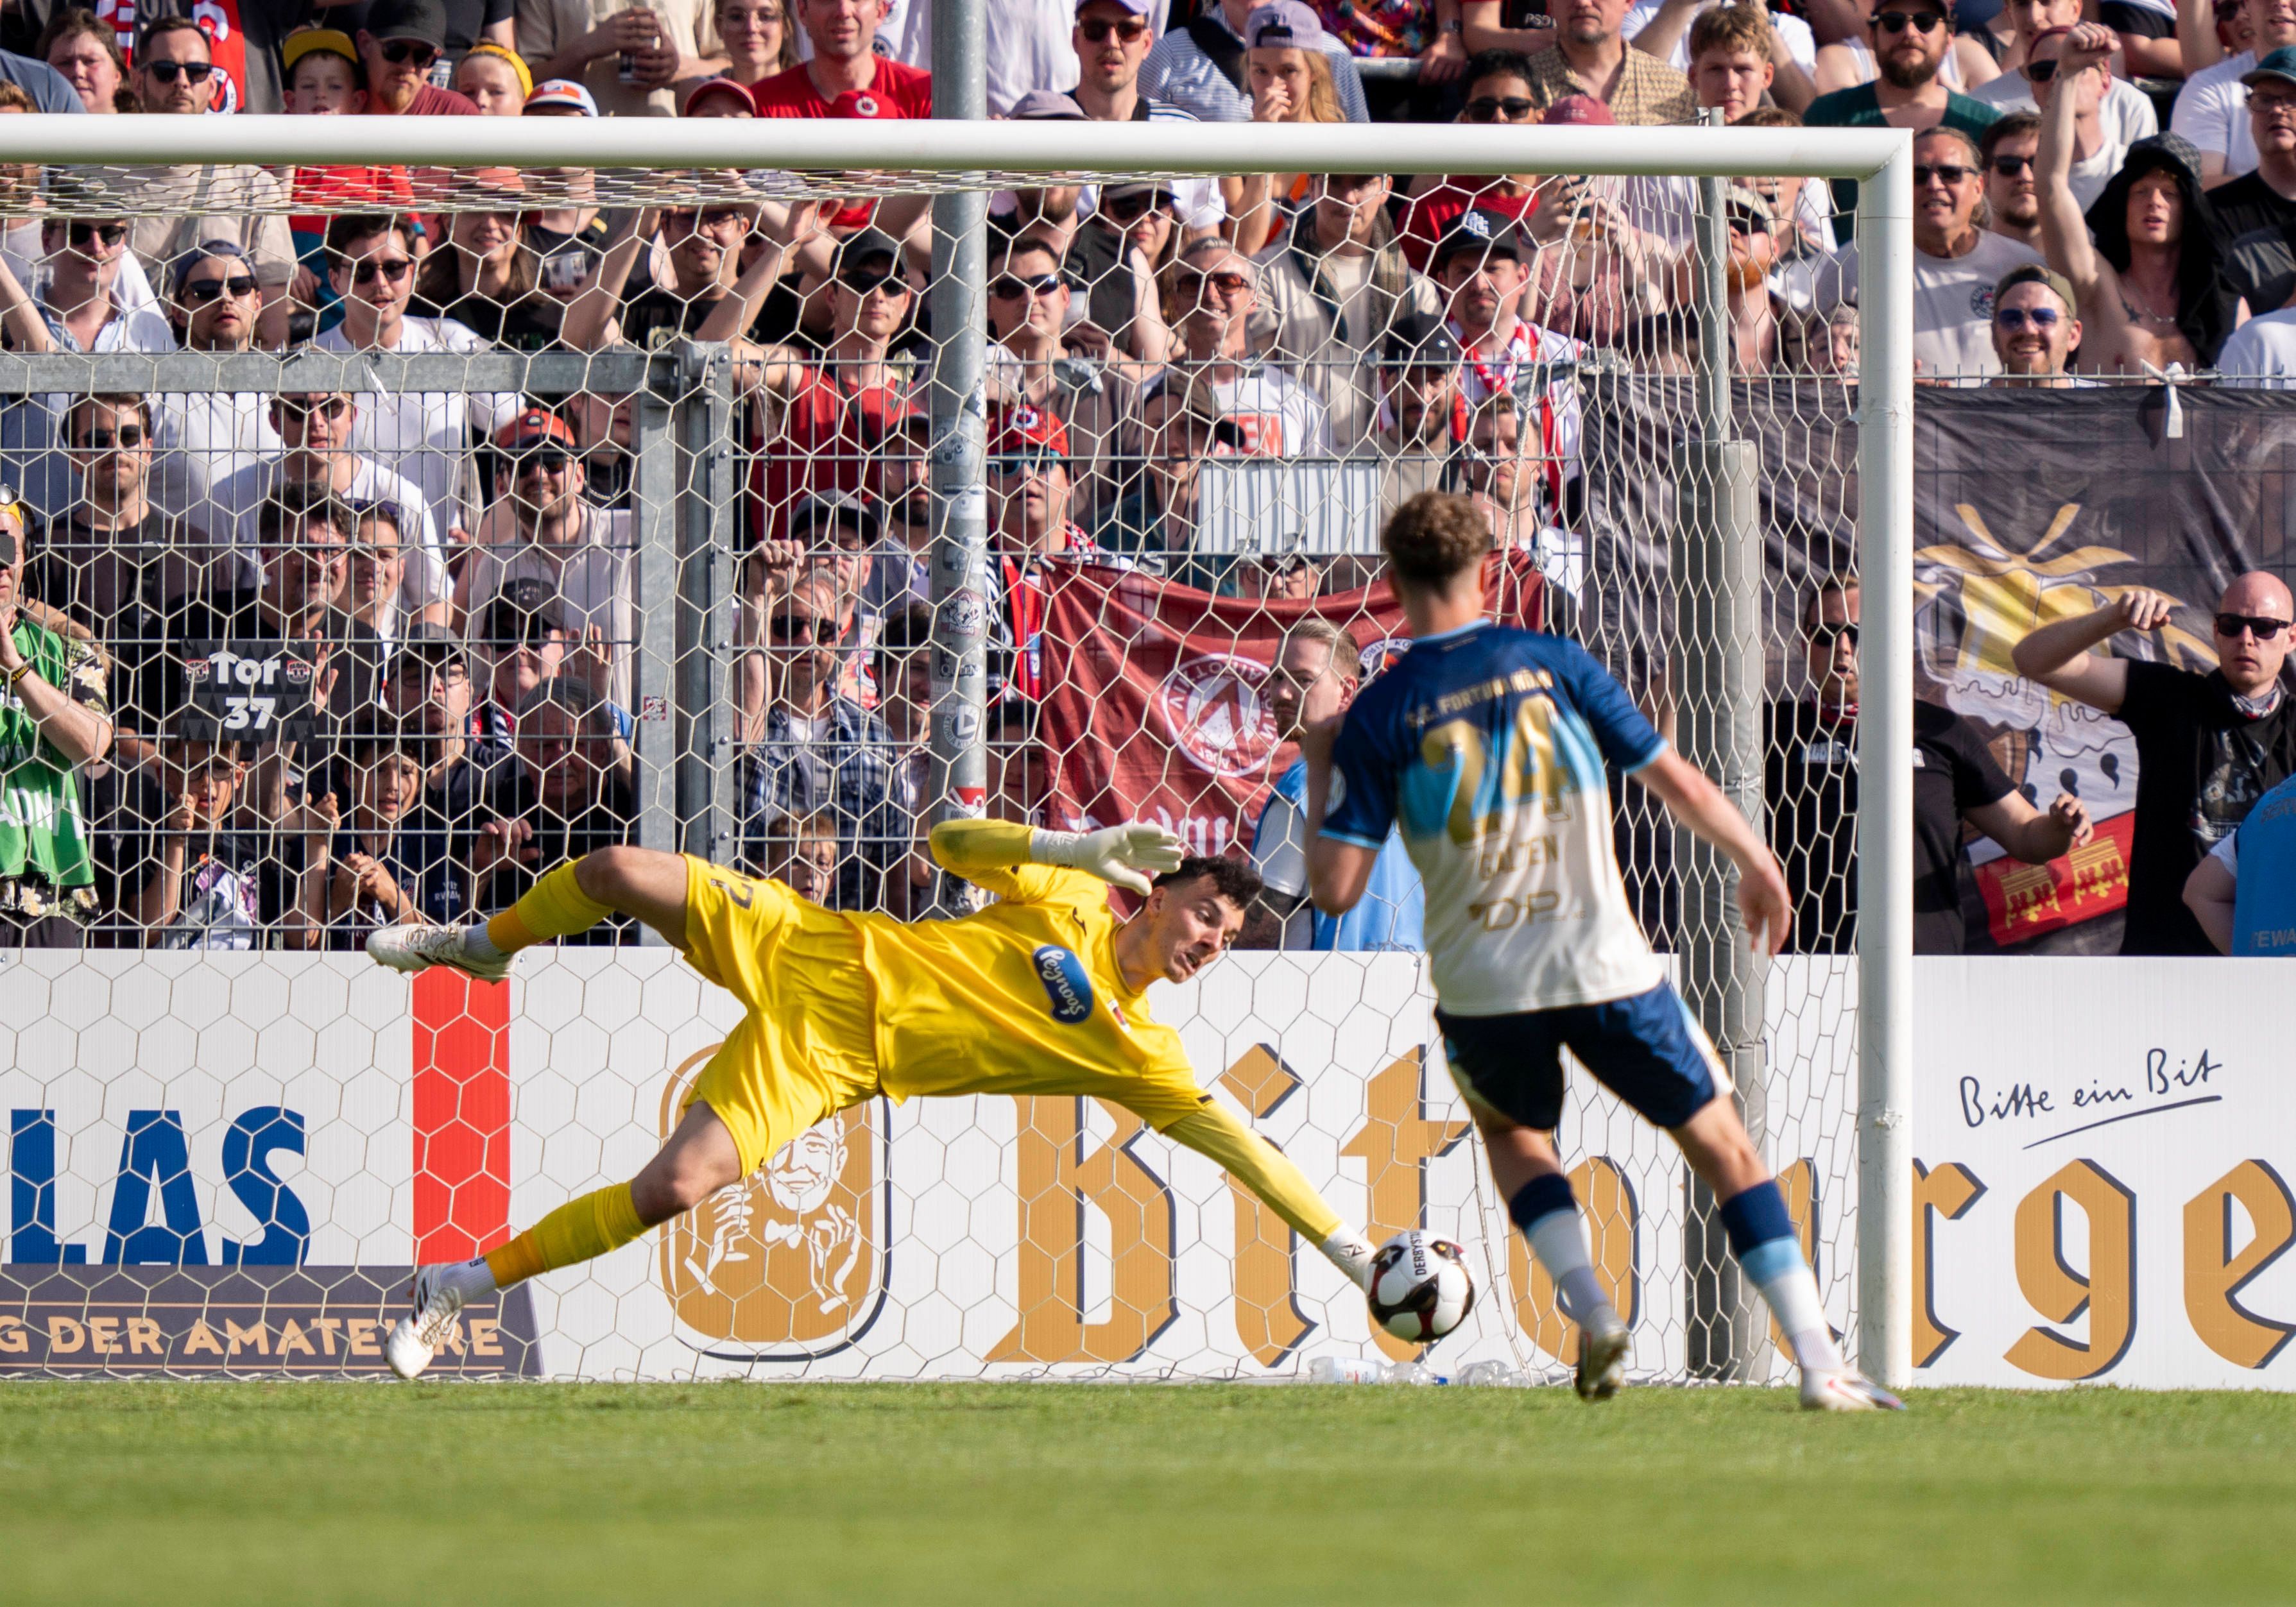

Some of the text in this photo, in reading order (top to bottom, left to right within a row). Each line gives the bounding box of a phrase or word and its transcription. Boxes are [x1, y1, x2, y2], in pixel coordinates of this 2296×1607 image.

[209, 650, 280, 685] Tor
[225, 697, 276, 729] 37
[1420, 692, 1569, 848] 24
[1960, 1048, 2223, 1128] Bitte ein Bit
[11, 1106, 311, 1266] LAS
[47, 1316, 164, 1355] DER
[183, 1318, 504, 1356] AMATERE
